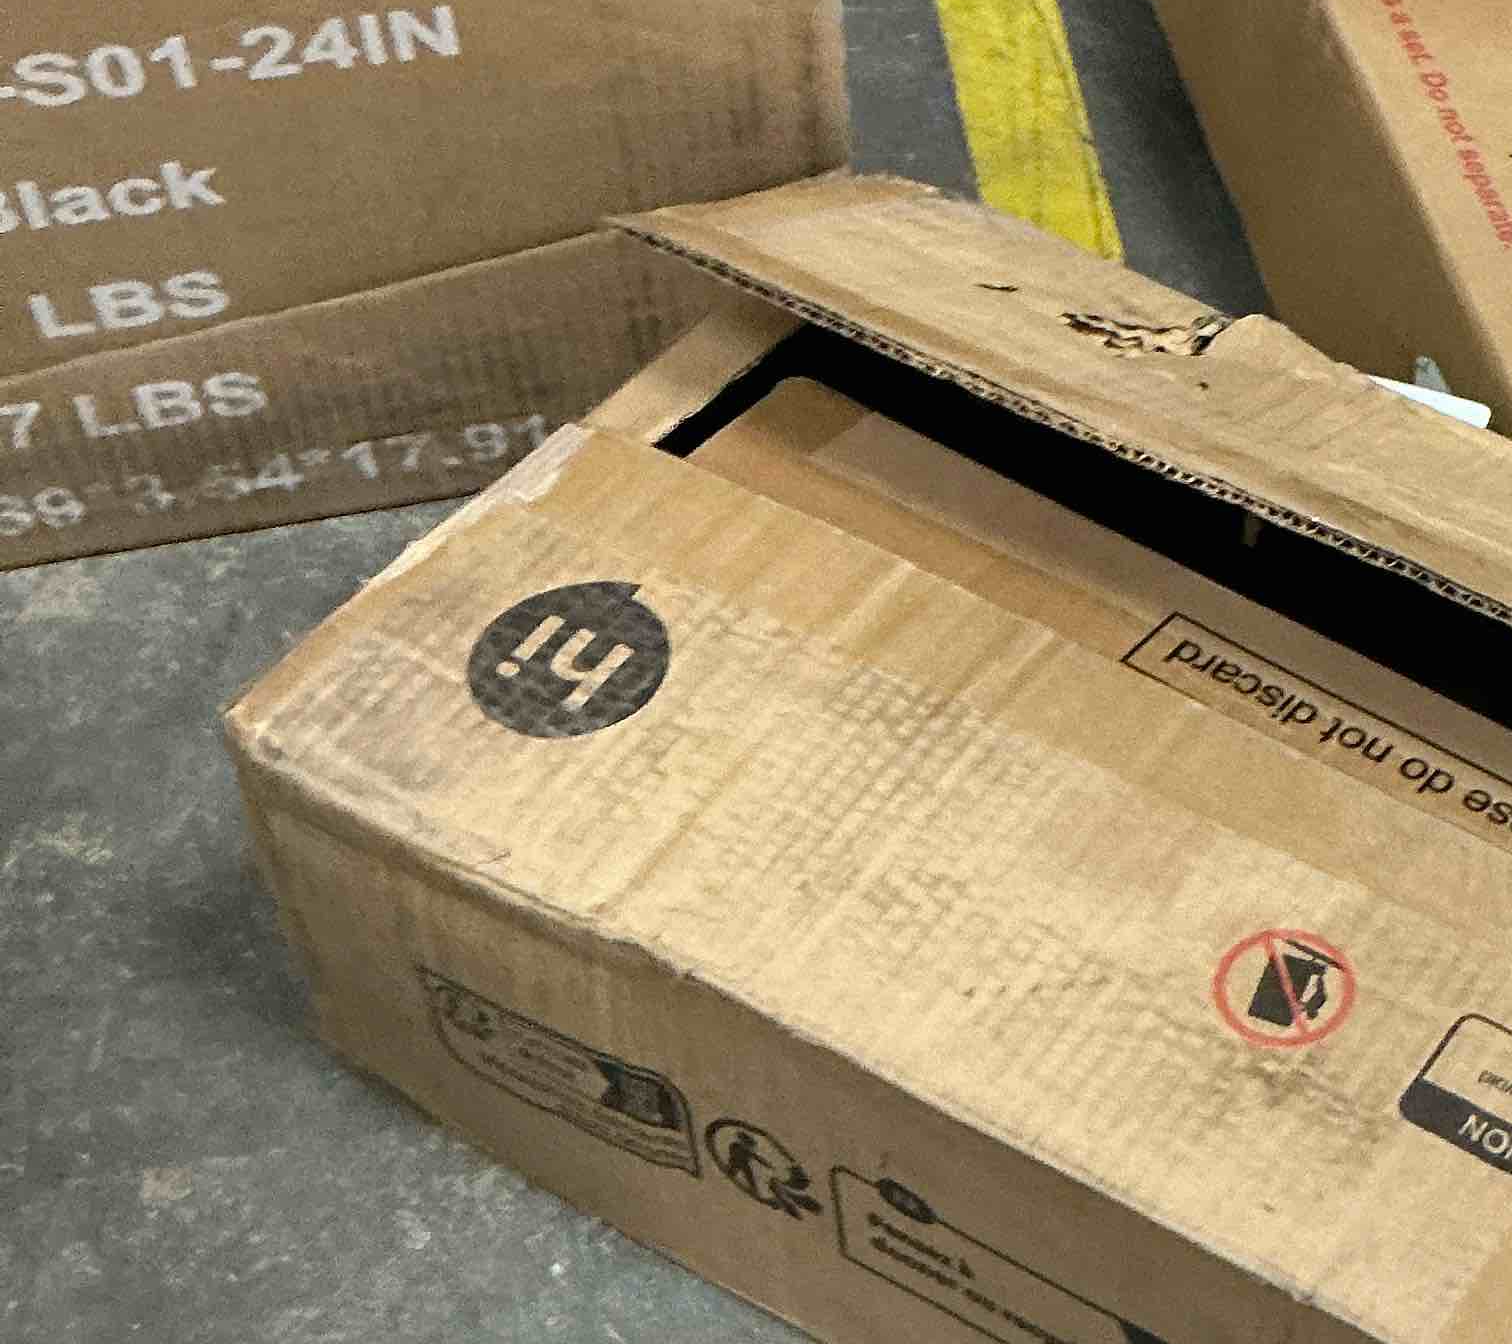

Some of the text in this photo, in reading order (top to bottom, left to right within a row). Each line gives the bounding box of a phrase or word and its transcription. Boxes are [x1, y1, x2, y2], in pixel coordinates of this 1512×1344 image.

[1390, 11, 1412, 25] a
[1421, 71, 1449, 102] Do
[1438, 106, 1473, 143] not
[28, 271, 231, 341] LBS
[73, 371, 268, 439] LBS
[496, 615, 634, 711] hi
[1167, 639, 1318, 725] discard
[1319, 715, 1396, 763] not
[1399, 755, 1456, 795] do
